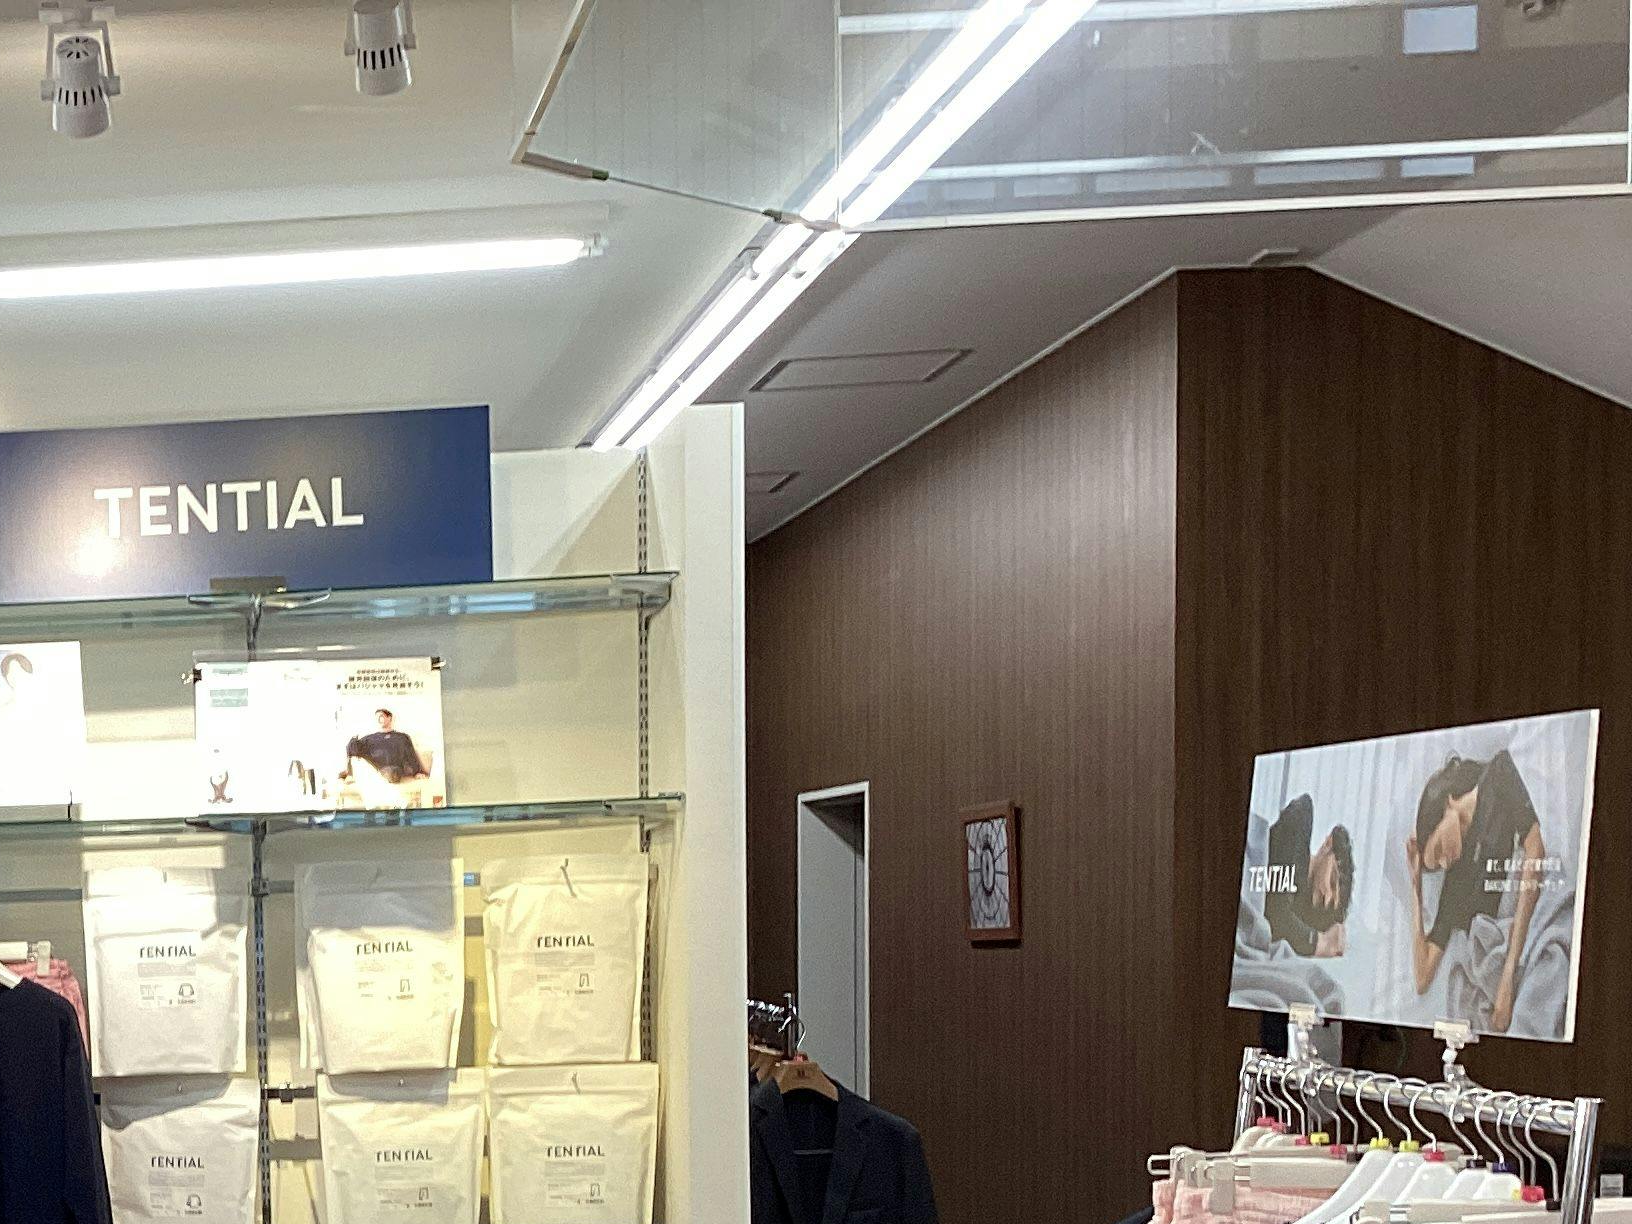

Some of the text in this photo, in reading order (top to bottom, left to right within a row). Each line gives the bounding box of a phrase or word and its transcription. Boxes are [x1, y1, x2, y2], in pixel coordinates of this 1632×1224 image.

[93, 476, 364, 540] TENTIAL
[1249, 864, 1298, 893] TENTIAL
[356, 940, 414, 956] TENTIAL
[536, 935, 594, 949] TENTIAL
[139, 945, 197, 959] TENTIAL
[376, 1149, 433, 1164] TENTIAL
[547, 1144, 605, 1158] TENTIAL
[151, 1155, 205, 1169] TENTIAL
